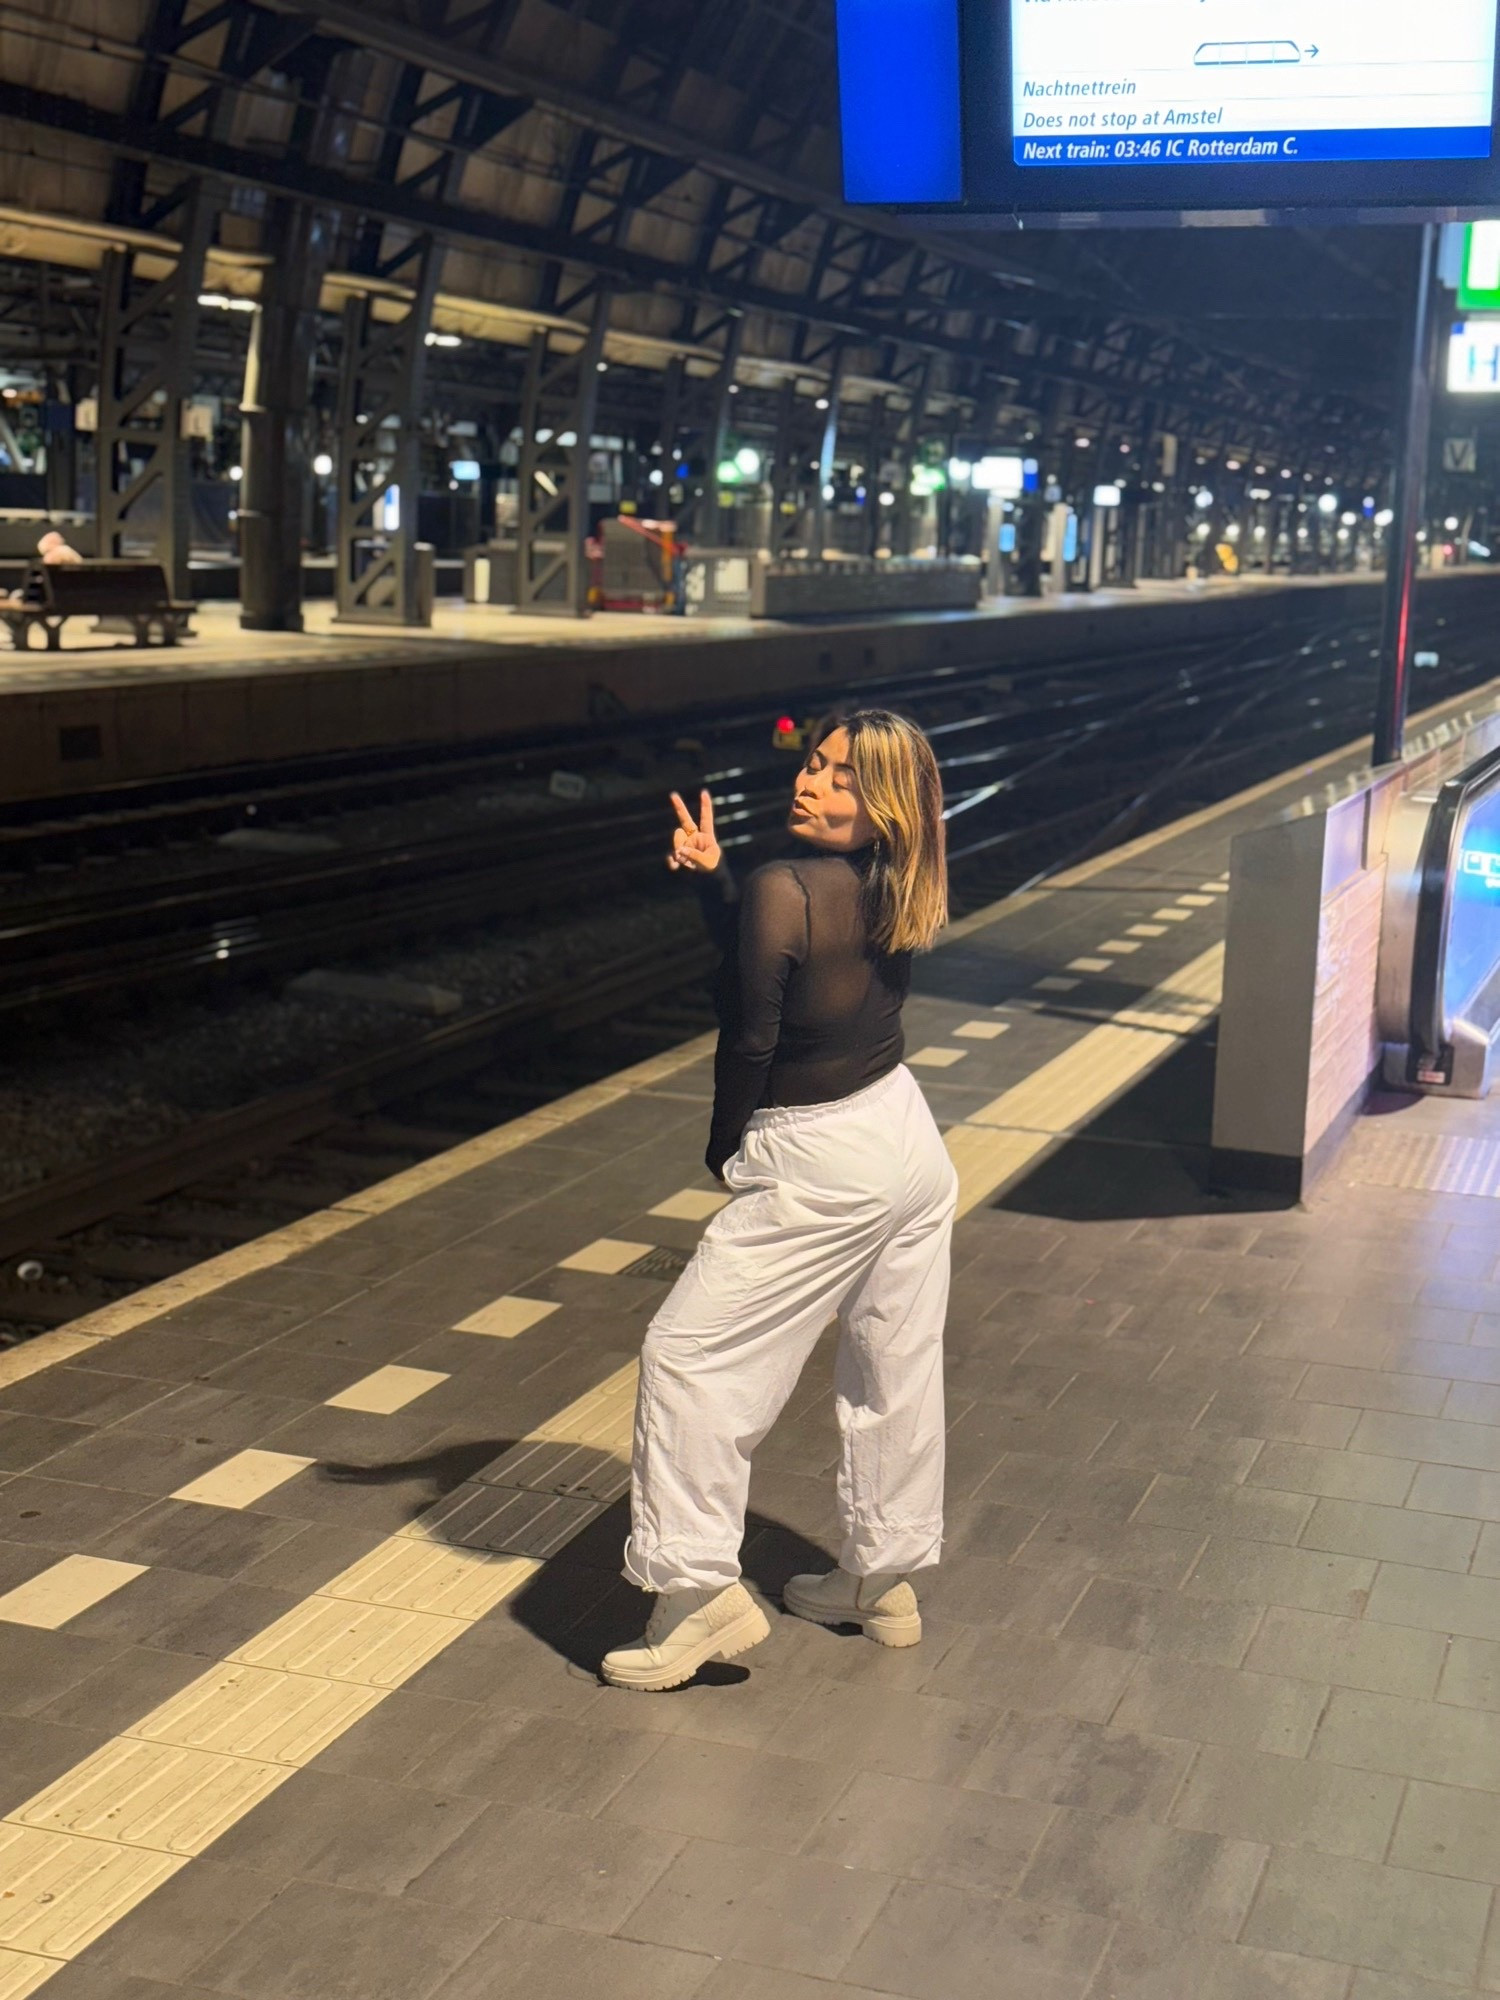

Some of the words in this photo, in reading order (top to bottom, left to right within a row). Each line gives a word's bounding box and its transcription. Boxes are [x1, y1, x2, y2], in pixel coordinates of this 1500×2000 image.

[1023, 79, 1137, 97] Nachtnettrein
[1023, 112, 1063, 128] Does
[1068, 111, 1096, 127] not
[1101, 110, 1137, 130] stop
[1143, 110, 1160, 125] at
[1164, 107, 1223, 126] Amstel
[1023, 141, 1063, 159] Next
[1067, 140, 1110, 158] train:
[1114, 139, 1161, 157] 03:46
[1166, 139, 1184, 157] IC
[1187, 137, 1278, 156] Rotterdam
[1283, 137, 1299, 155] C.
